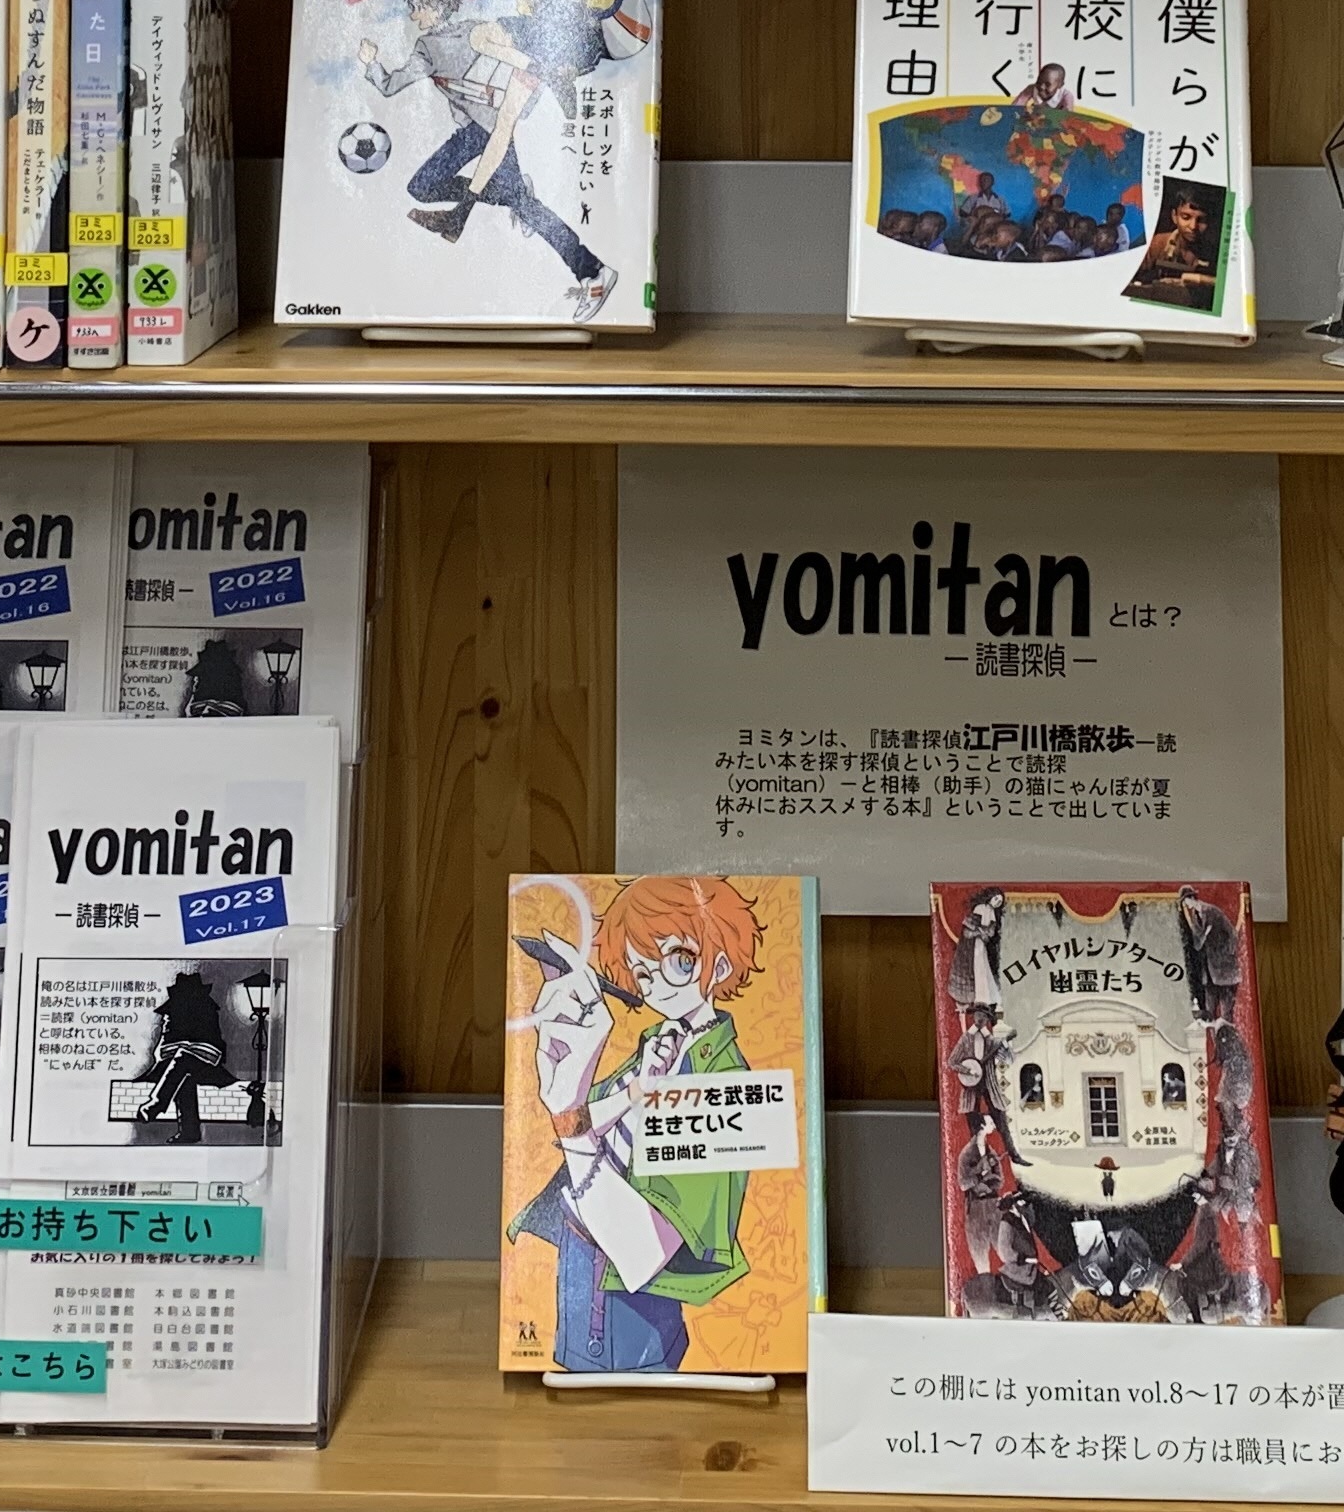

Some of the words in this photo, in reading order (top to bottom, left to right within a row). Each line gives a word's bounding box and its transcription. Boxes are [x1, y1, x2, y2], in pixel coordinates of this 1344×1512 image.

[561, 122, 577, 154] 君へ
[580, 88, 598, 192] 仕事にしたい
[599, 88, 614, 176] スポーツを
[79, 230, 112, 241] 2023
[80, 218, 101, 228] ヨミ
[285, 303, 341, 316] Gakken
[20, 318, 50, 348] ケ
[127, 492, 308, 553] omitan
[218, 566, 294, 593] 2022
[726, 520, 1091, 650] yomitan
[1109, 603, 1182, 628] とは？
[976, 643, 1066, 678] 読書探偵
[716, 752, 1067, 775] みたい本を探す探偵ということで読探
[716, 818, 746, 838] す。
[48, 810, 293, 884] yomitan
[188, 885, 275, 918] 2023
[77, 902, 140, 928] 読書探偵
[195, 915, 267, 938] Vol.17
[1001, 936, 1186, 985] ロイヤルシアターの
[1050, 968, 1143, 994] 幽霊たち
[40, 996, 156, 1008] 読みたい本を探す探偵
[40, 1028, 126, 1040] と呼ばれている。
[644, 1084, 784, 1110] オタクを武器に
[644, 1112, 743, 1136] 生きていく
[646, 1144, 706, 1162] 吉田尚記
[890, 1374, 1017, 1401] この棚には
[1026, 1380, 1120, 1407] yomitan
